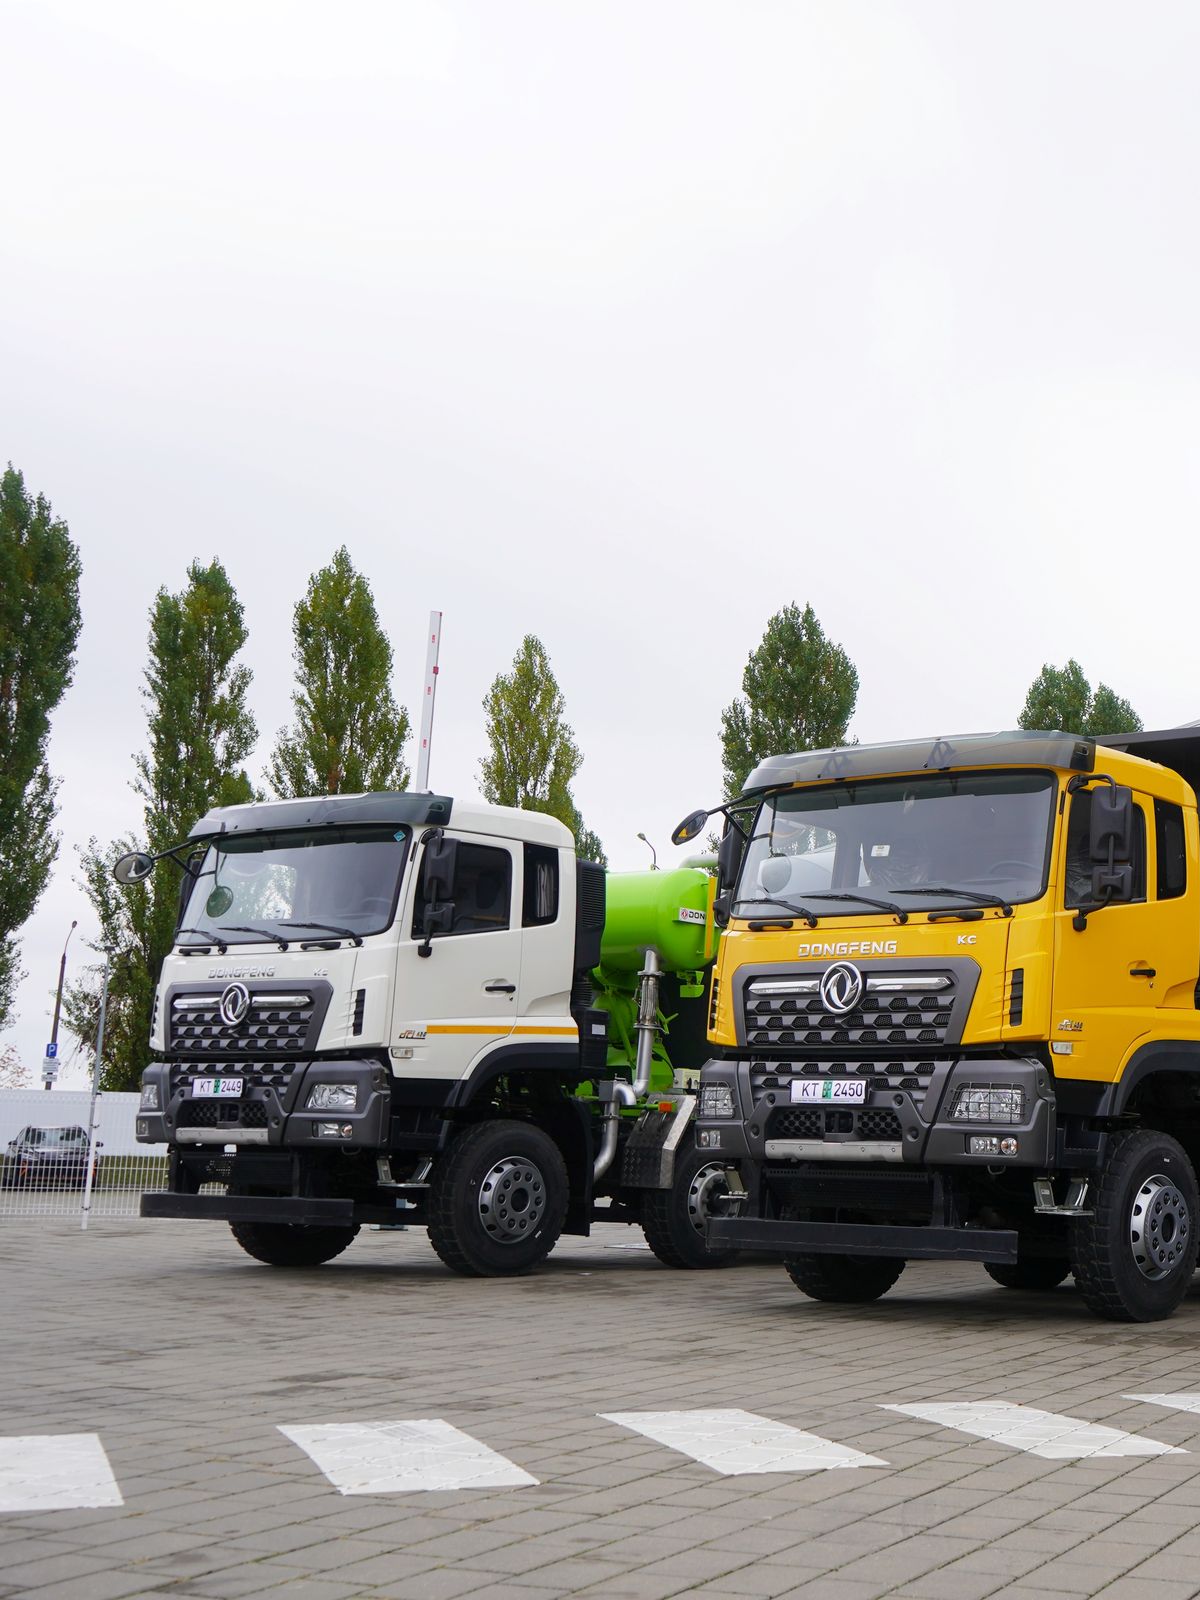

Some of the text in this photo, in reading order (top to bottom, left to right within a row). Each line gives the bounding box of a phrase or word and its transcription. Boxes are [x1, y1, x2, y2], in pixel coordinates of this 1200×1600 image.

[688, 911, 706, 920] DON
[957, 935, 977, 945] KC
[798, 940, 898, 957] DONGFENG
[208, 966, 276, 979] DONGFENG
[48, 1044, 56, 1056] P
[221, 1080, 242, 1093] 2449
[801, 1082, 819, 1097] KT
[833, 1082, 863, 1097] 2450
